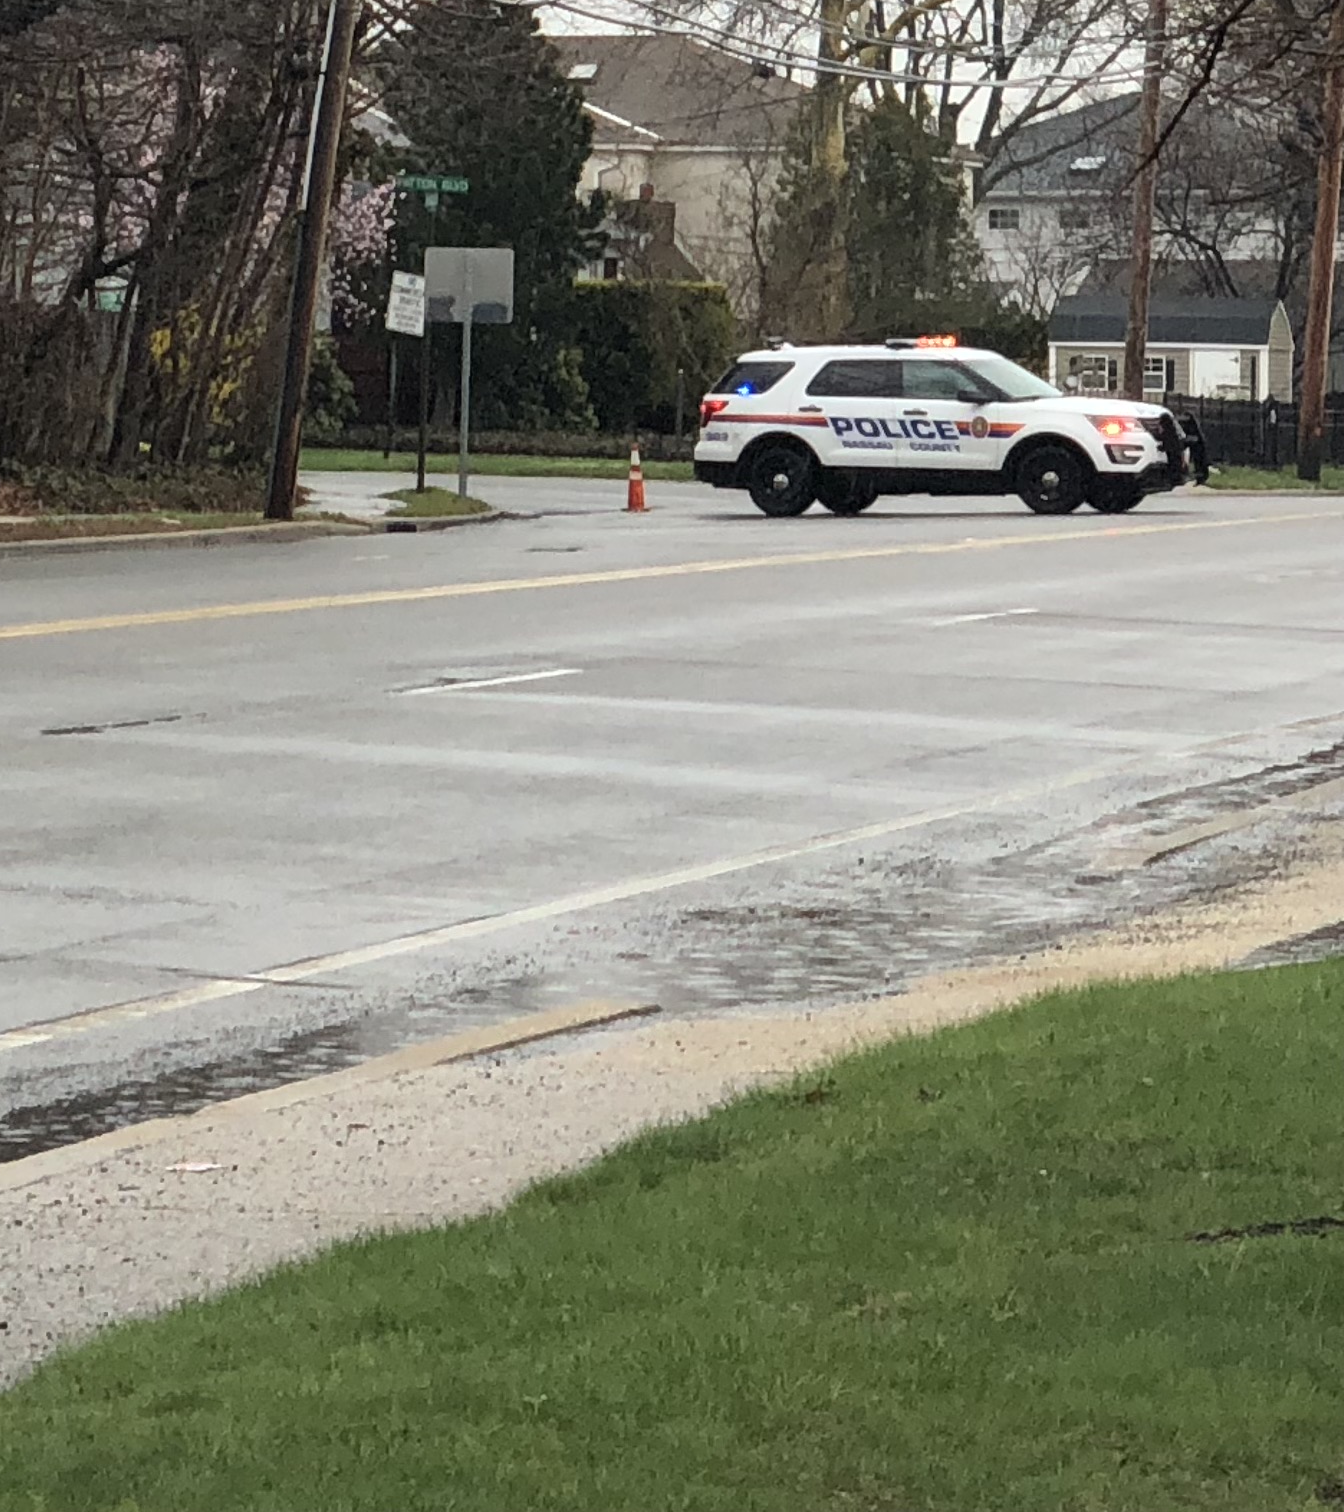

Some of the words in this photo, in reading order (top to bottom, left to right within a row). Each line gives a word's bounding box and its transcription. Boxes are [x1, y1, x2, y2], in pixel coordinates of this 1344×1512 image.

[441, 179, 468, 191] BLVD
[829, 416, 959, 440] POLICE
[842, 440, 894, 450] NASSAU
[909, 442, 961, 453] COUNTY
